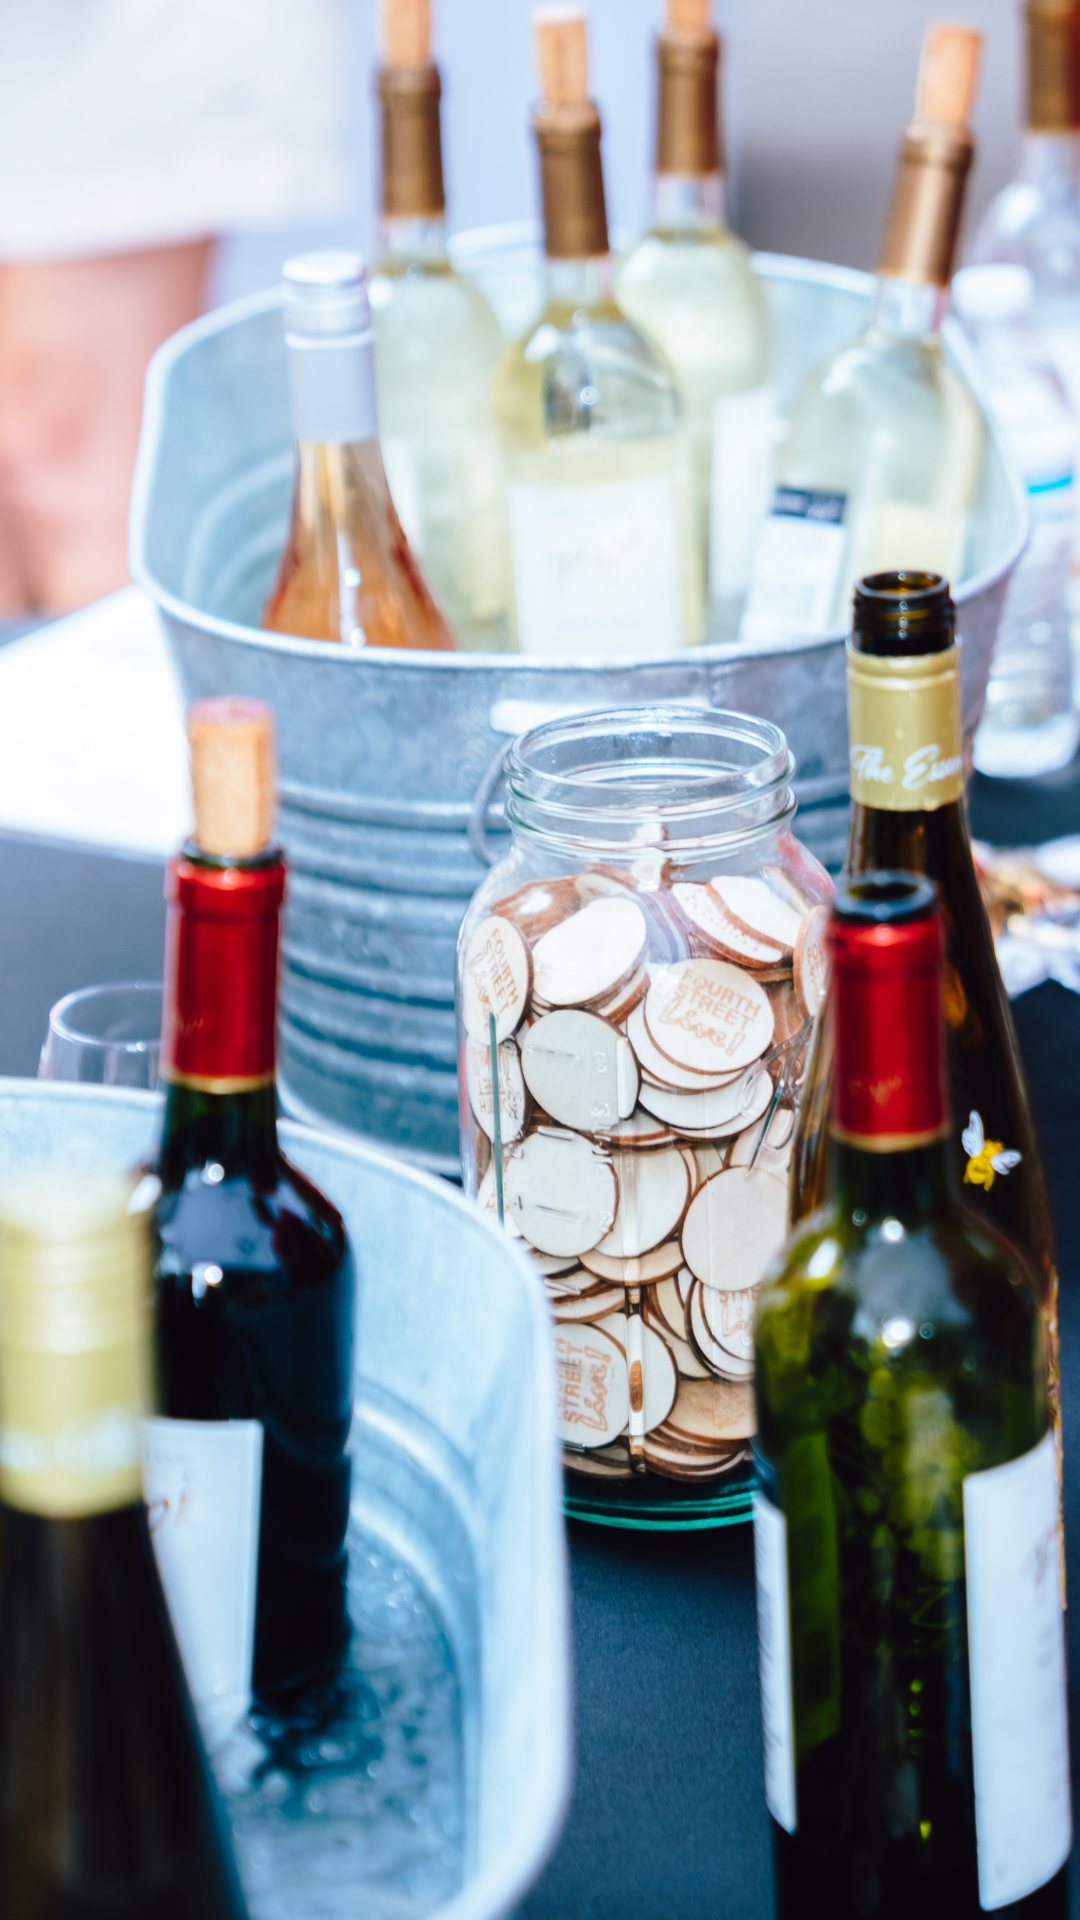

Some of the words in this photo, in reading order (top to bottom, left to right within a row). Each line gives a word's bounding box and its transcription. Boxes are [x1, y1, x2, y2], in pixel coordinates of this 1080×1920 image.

[850, 744, 894, 784] The
[482, 939, 510, 1014] STREET
[491, 927, 519, 1006] FOURTH
[682, 968, 762, 1018] FOURTH
[658, 998, 746, 1057] Live!
[674, 982, 754, 1031] STREET
[563, 1341, 583, 1425] STREET
[579, 1346, 611, 1432] Live!
